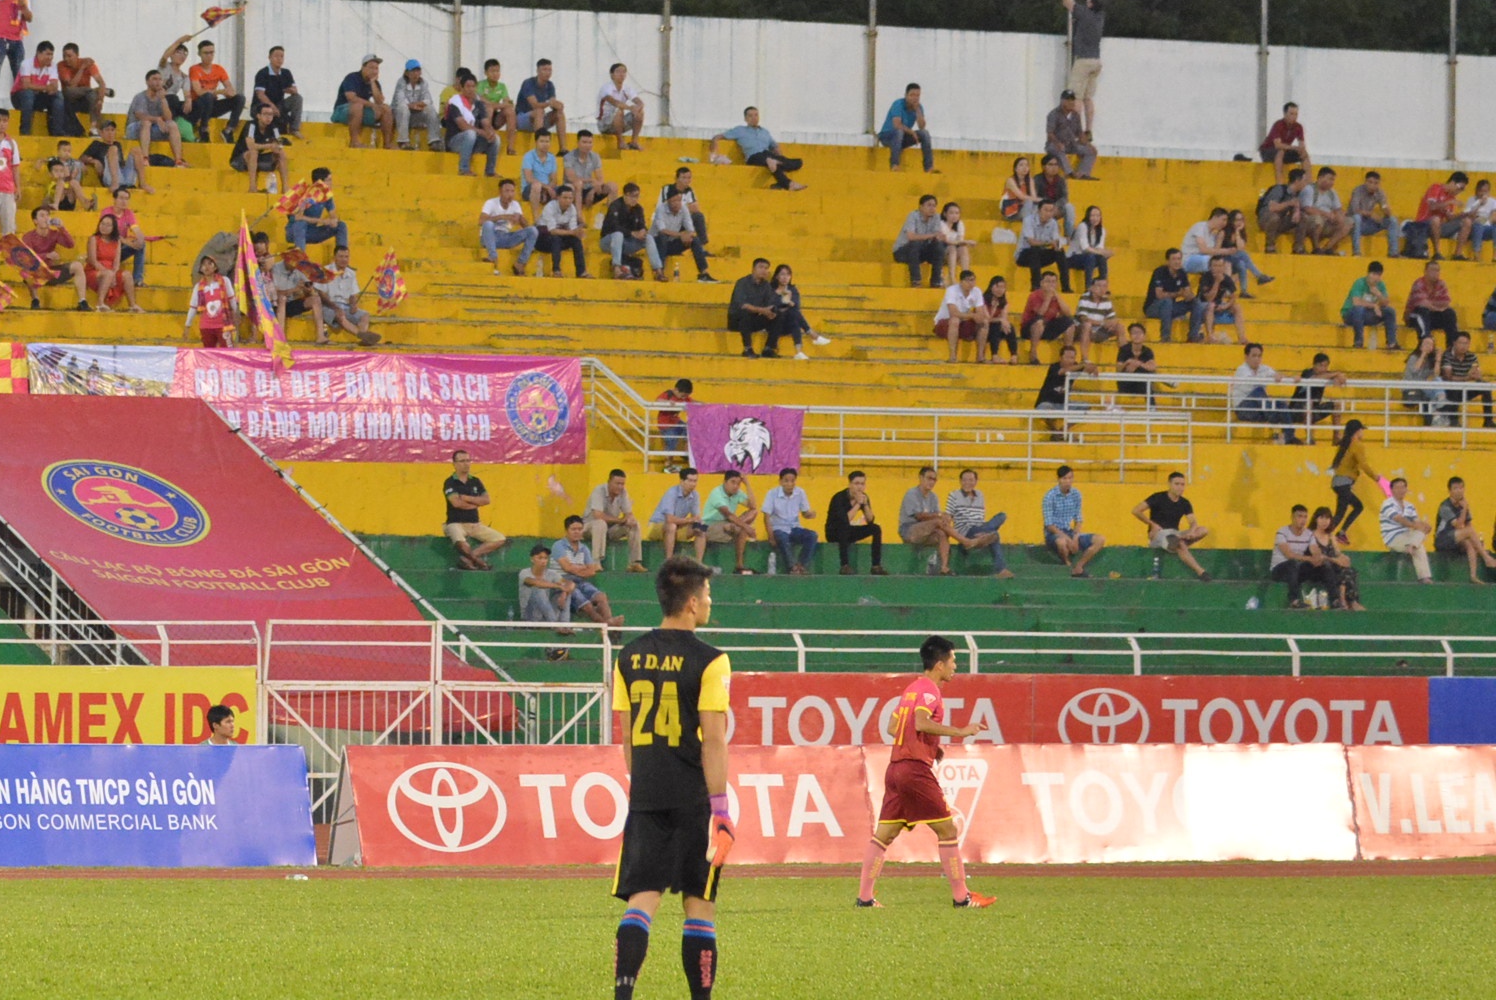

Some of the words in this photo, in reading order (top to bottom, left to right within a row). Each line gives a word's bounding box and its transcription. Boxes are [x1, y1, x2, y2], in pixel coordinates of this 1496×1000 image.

[345, 366, 399, 400] BÓNG
[405, 367, 433, 400] ĐÁ
[438, 373, 490, 406] SẠCH
[439, 408, 491, 441] CÁCH
[62, 466, 91, 481] SAI
[94, 466, 140, 484] GON
[80, 513, 177, 542] FOOTBALL
[175, 515, 199, 538] CLUB
[91, 568, 170, 588] SAIGON
[171, 577, 277, 592] FOOTBALL
[276, 576, 331, 591] CLUB
[165, 566, 228, 580] BÓNG
[229, 566, 261, 580] ĐÁ
[262, 562, 298, 578] SÀI
[299, 555, 352, 575] GÒN
[630, 679, 682, 747] 24
[1161, 697, 1403, 745] TOYOTA
[16, 771, 72, 805] HÀNG
[76, 778, 131, 805] TMCP
[136, 772, 168, 805] SÀI
[173, 772, 216, 805] GÒN
[519, 771, 845, 840] TOTA
[37, 814, 163, 830] COMMERCIAL
[168, 814, 219, 831] BANK
